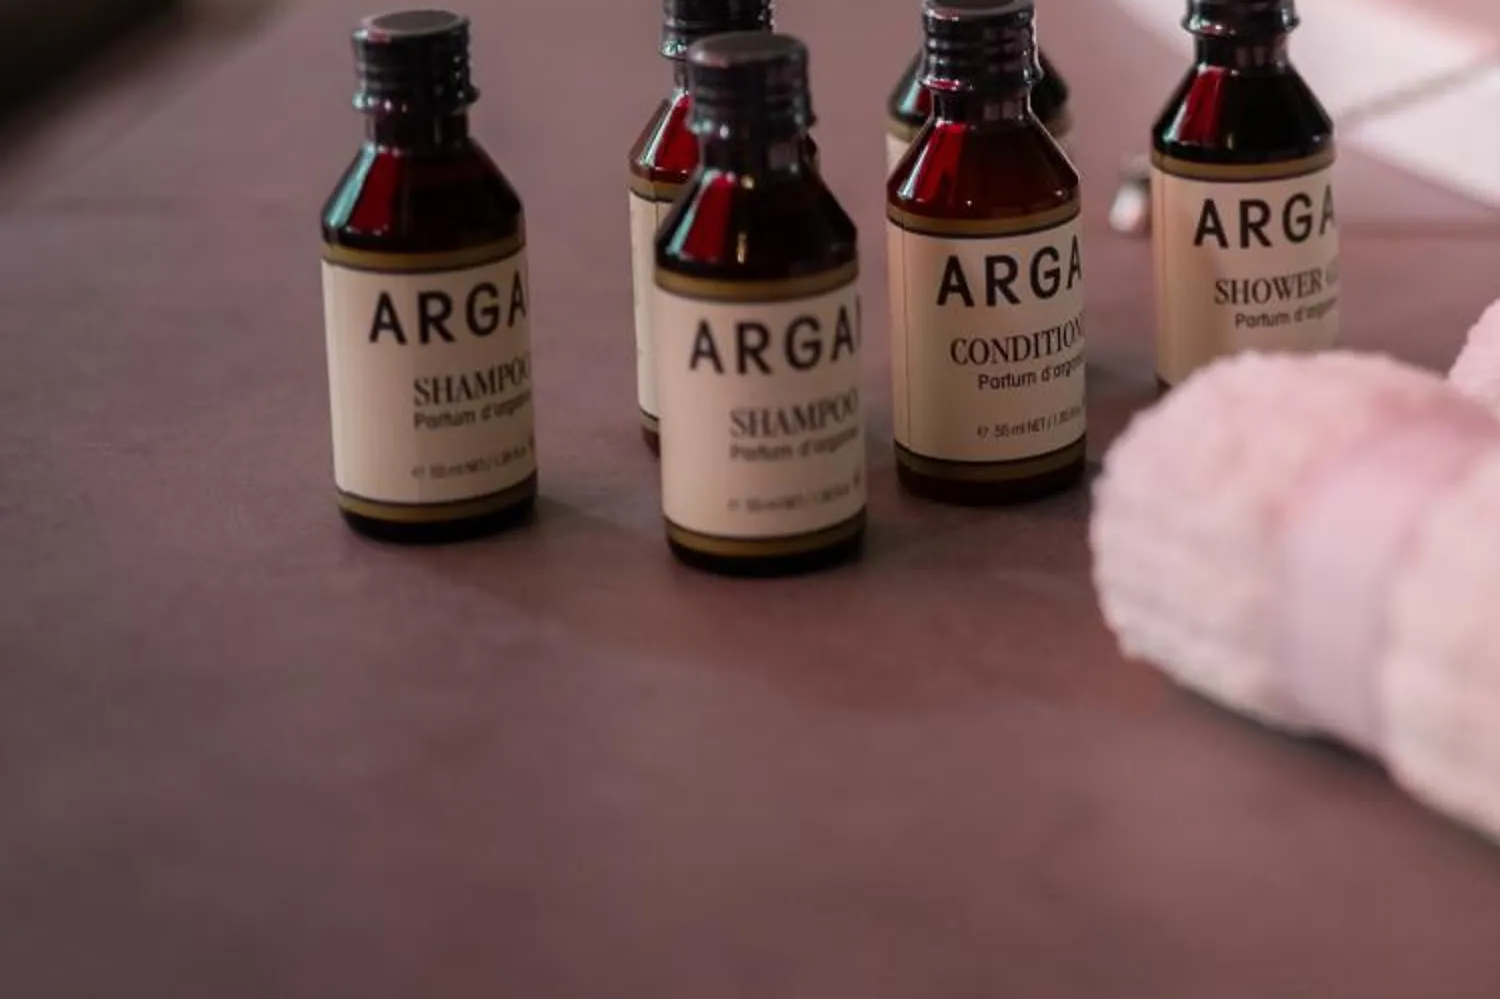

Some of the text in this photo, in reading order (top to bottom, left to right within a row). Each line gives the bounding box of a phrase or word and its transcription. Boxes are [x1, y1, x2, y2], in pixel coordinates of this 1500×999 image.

[1214, 267, 1323, 305] SHOWER
[689, 296, 861, 375] ARGA
[978, 371, 1037, 390] Parfum
